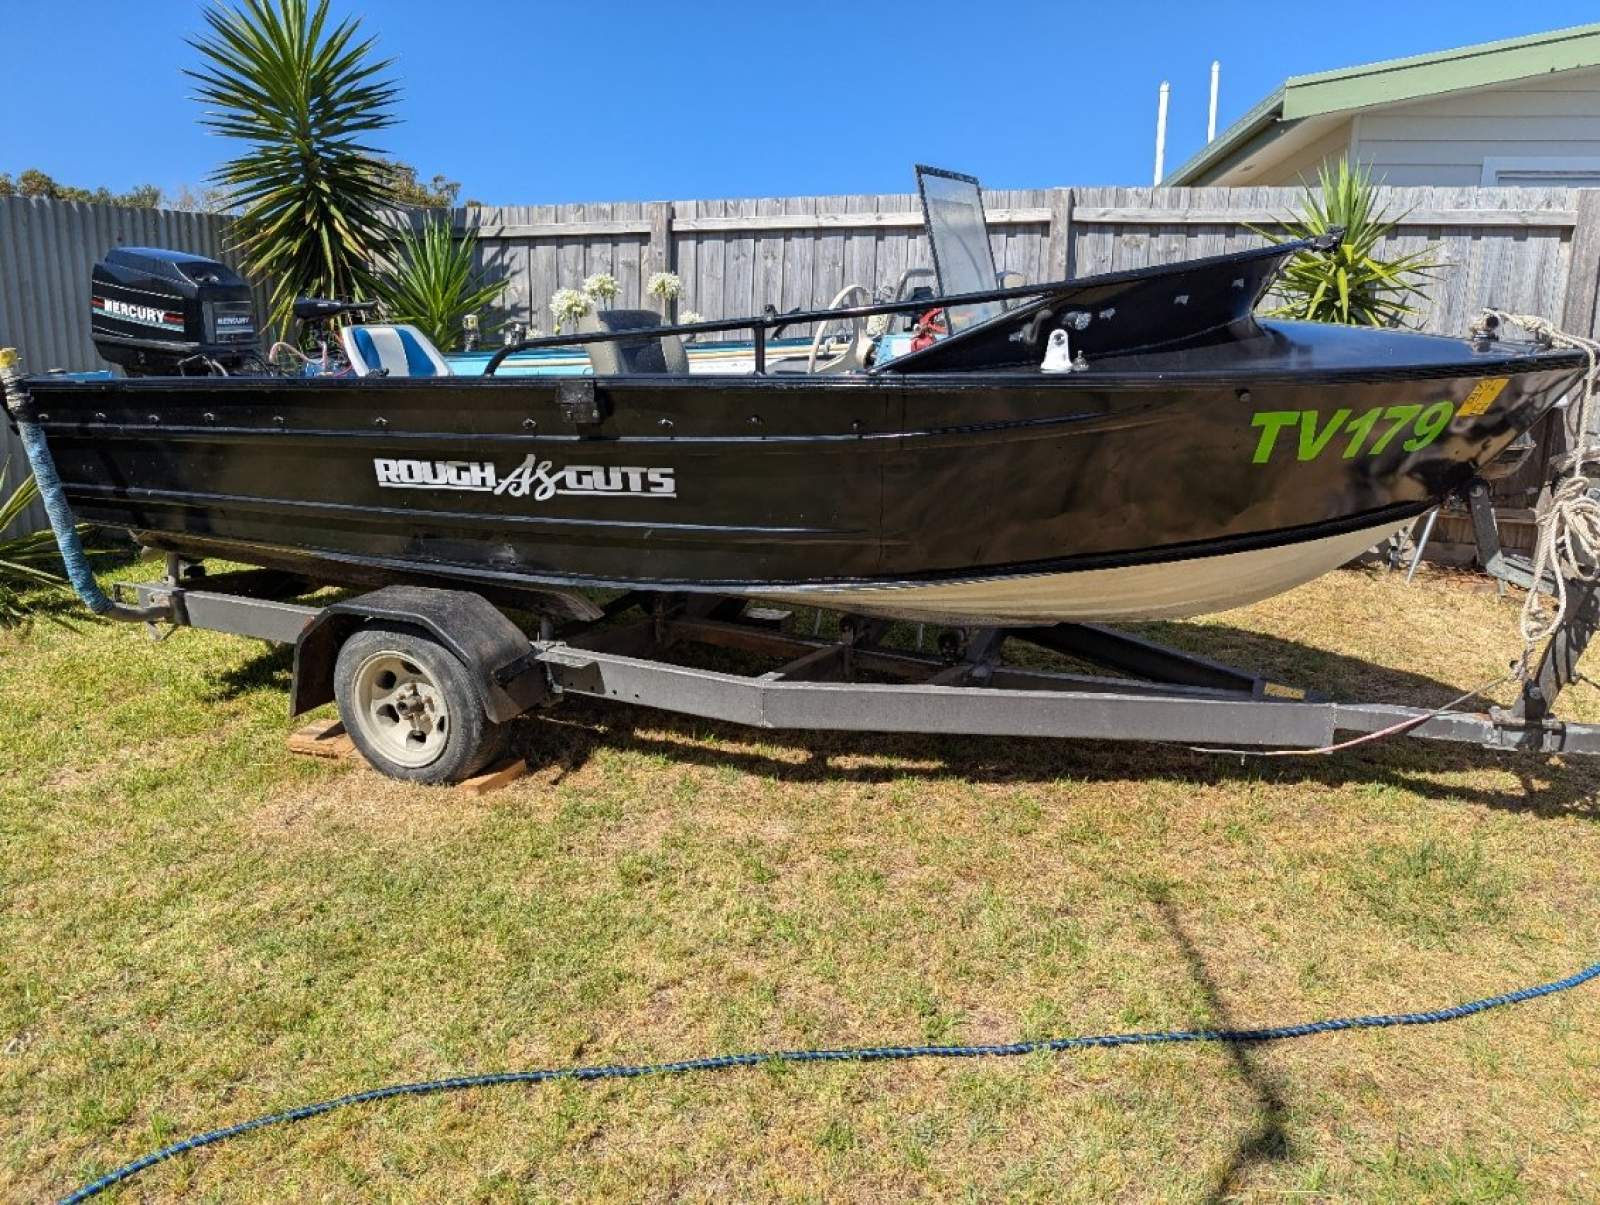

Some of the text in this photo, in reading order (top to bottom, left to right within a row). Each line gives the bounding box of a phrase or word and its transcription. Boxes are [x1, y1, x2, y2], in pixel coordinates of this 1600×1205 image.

[104, 299, 165, 324] MERCURY
[217, 316, 250, 326] MERCURY
[1251, 399, 1454, 464] TV179
[374, 458, 498, 487] ROUGH
[564, 465, 677, 493] GUTS
